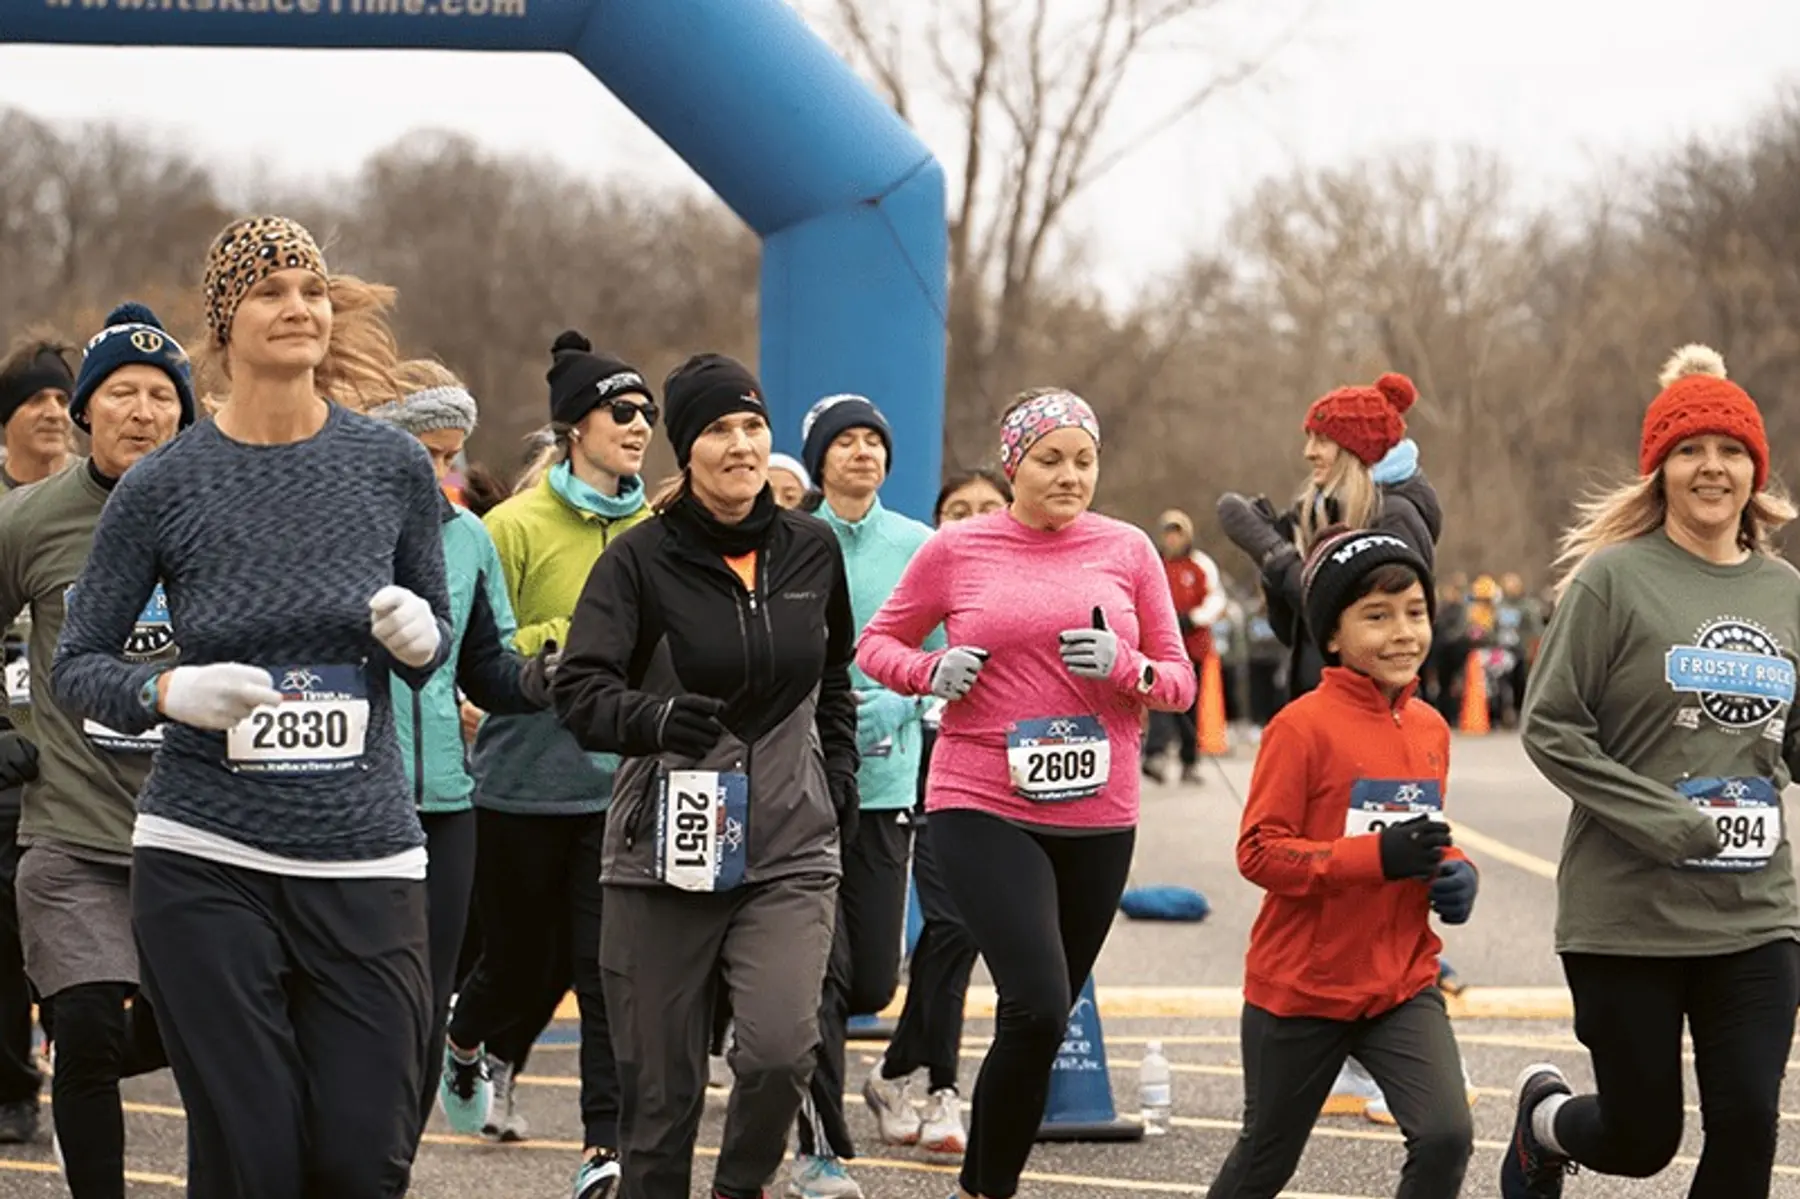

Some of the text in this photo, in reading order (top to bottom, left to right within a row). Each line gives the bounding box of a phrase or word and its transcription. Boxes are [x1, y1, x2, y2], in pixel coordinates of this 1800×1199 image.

[1680, 656, 1749, 678] FROSTY
[253, 709, 347, 749] 2830
[1028, 749, 1096, 782] 2609
[674, 792, 709, 867] 2651
[1716, 816, 1766, 848] 894
